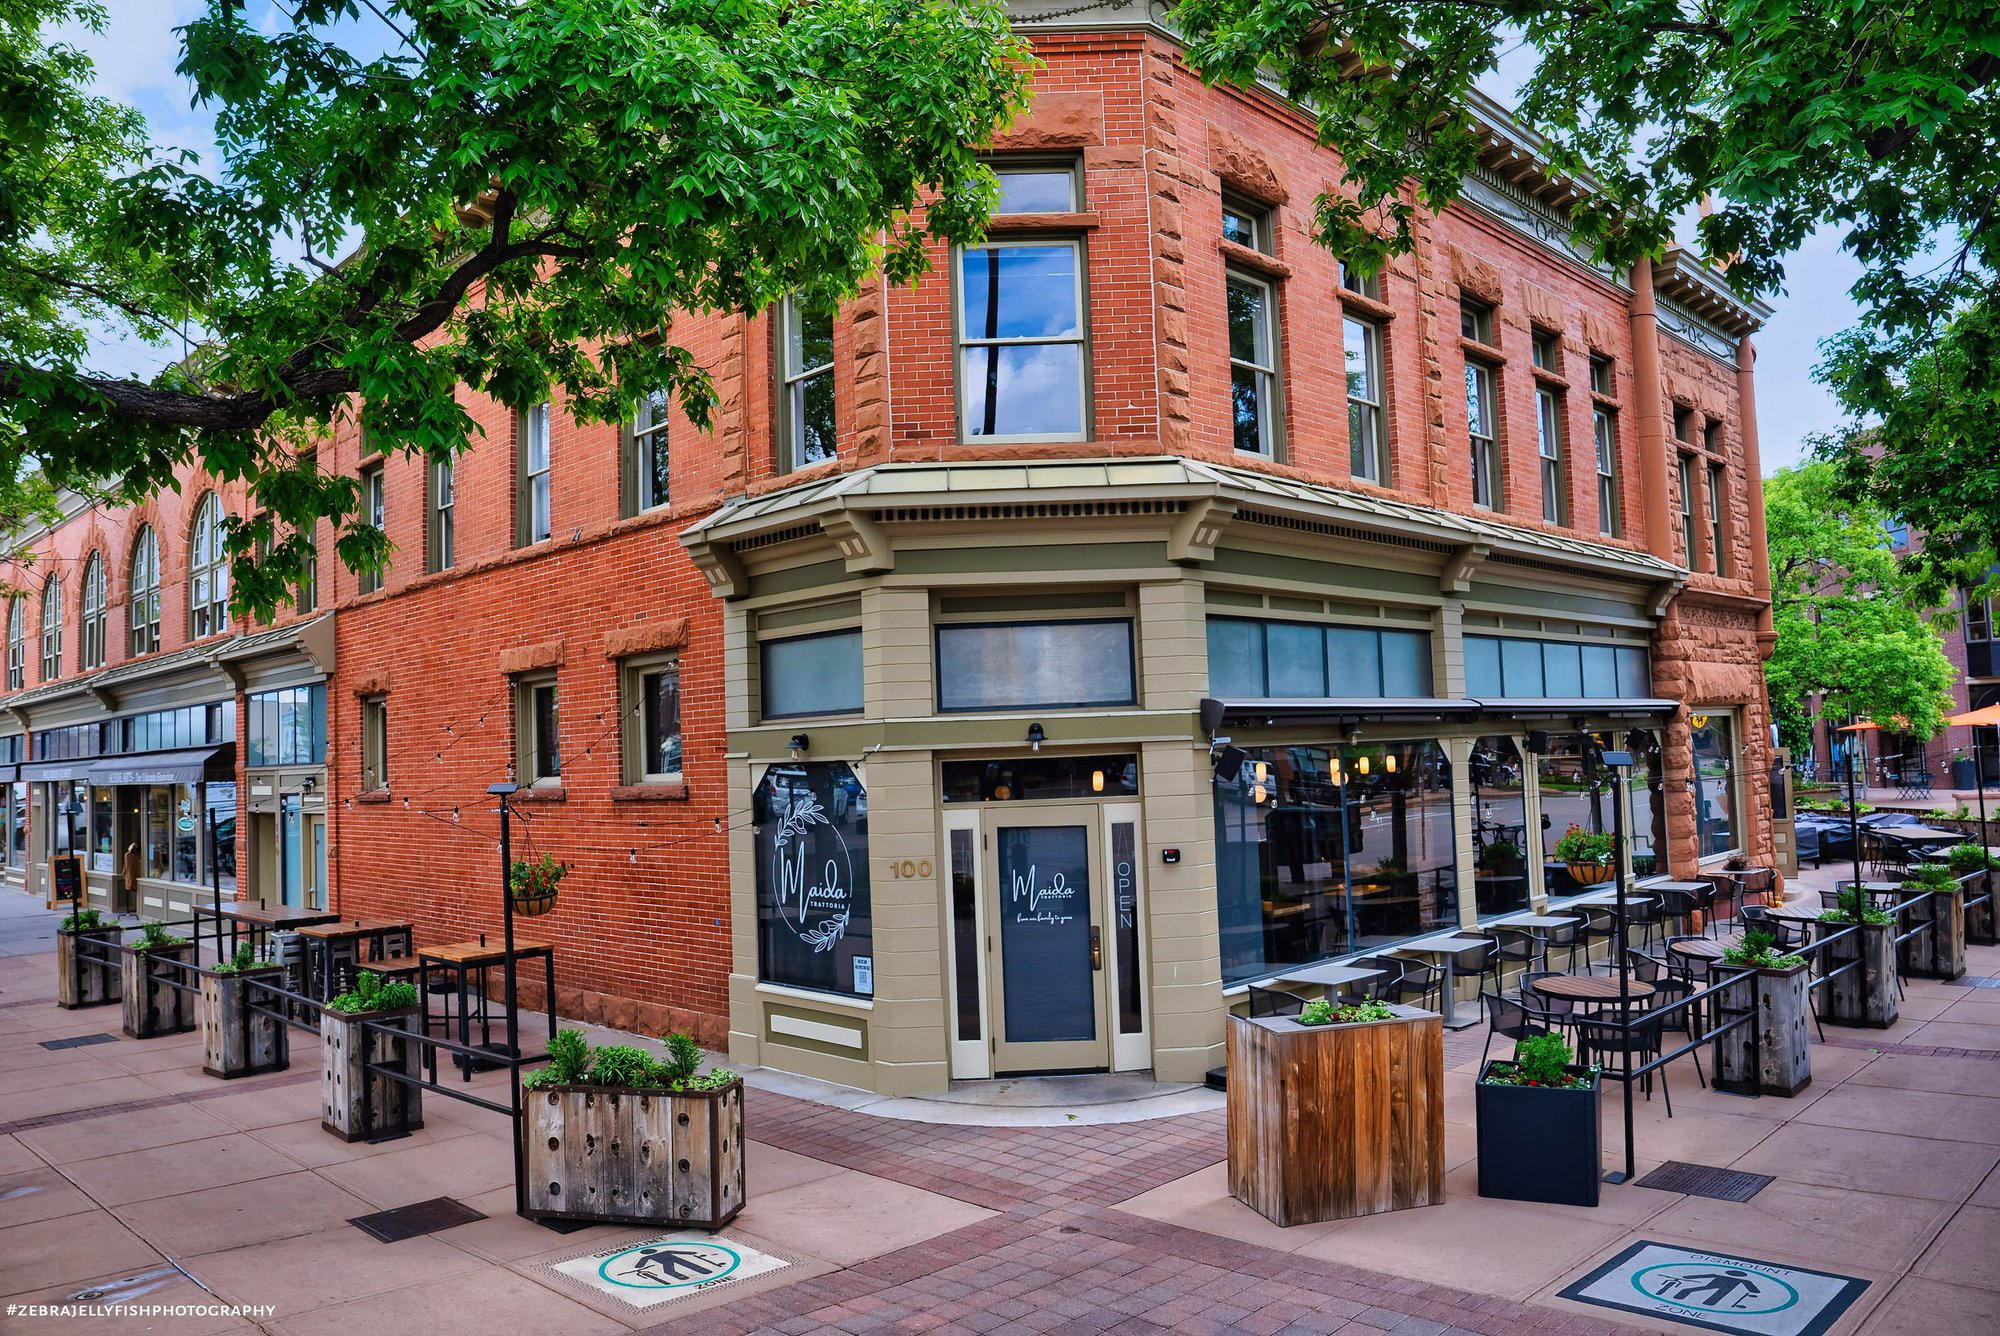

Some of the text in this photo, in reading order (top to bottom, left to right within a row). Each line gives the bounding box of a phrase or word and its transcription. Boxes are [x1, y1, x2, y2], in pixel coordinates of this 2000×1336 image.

[889, 860, 933, 879] 100
[780, 841, 848, 924] Maida
[1012, 864, 1076, 912] Maida
[810, 900, 846, 910] TRATTORIA
[1117, 861, 1132, 929] OPEN
[1690, 1253, 1794, 1276] DISMOUNT
[693, 1274, 738, 1290] ZONE
[1655, 1303, 1708, 1319] ZONE
